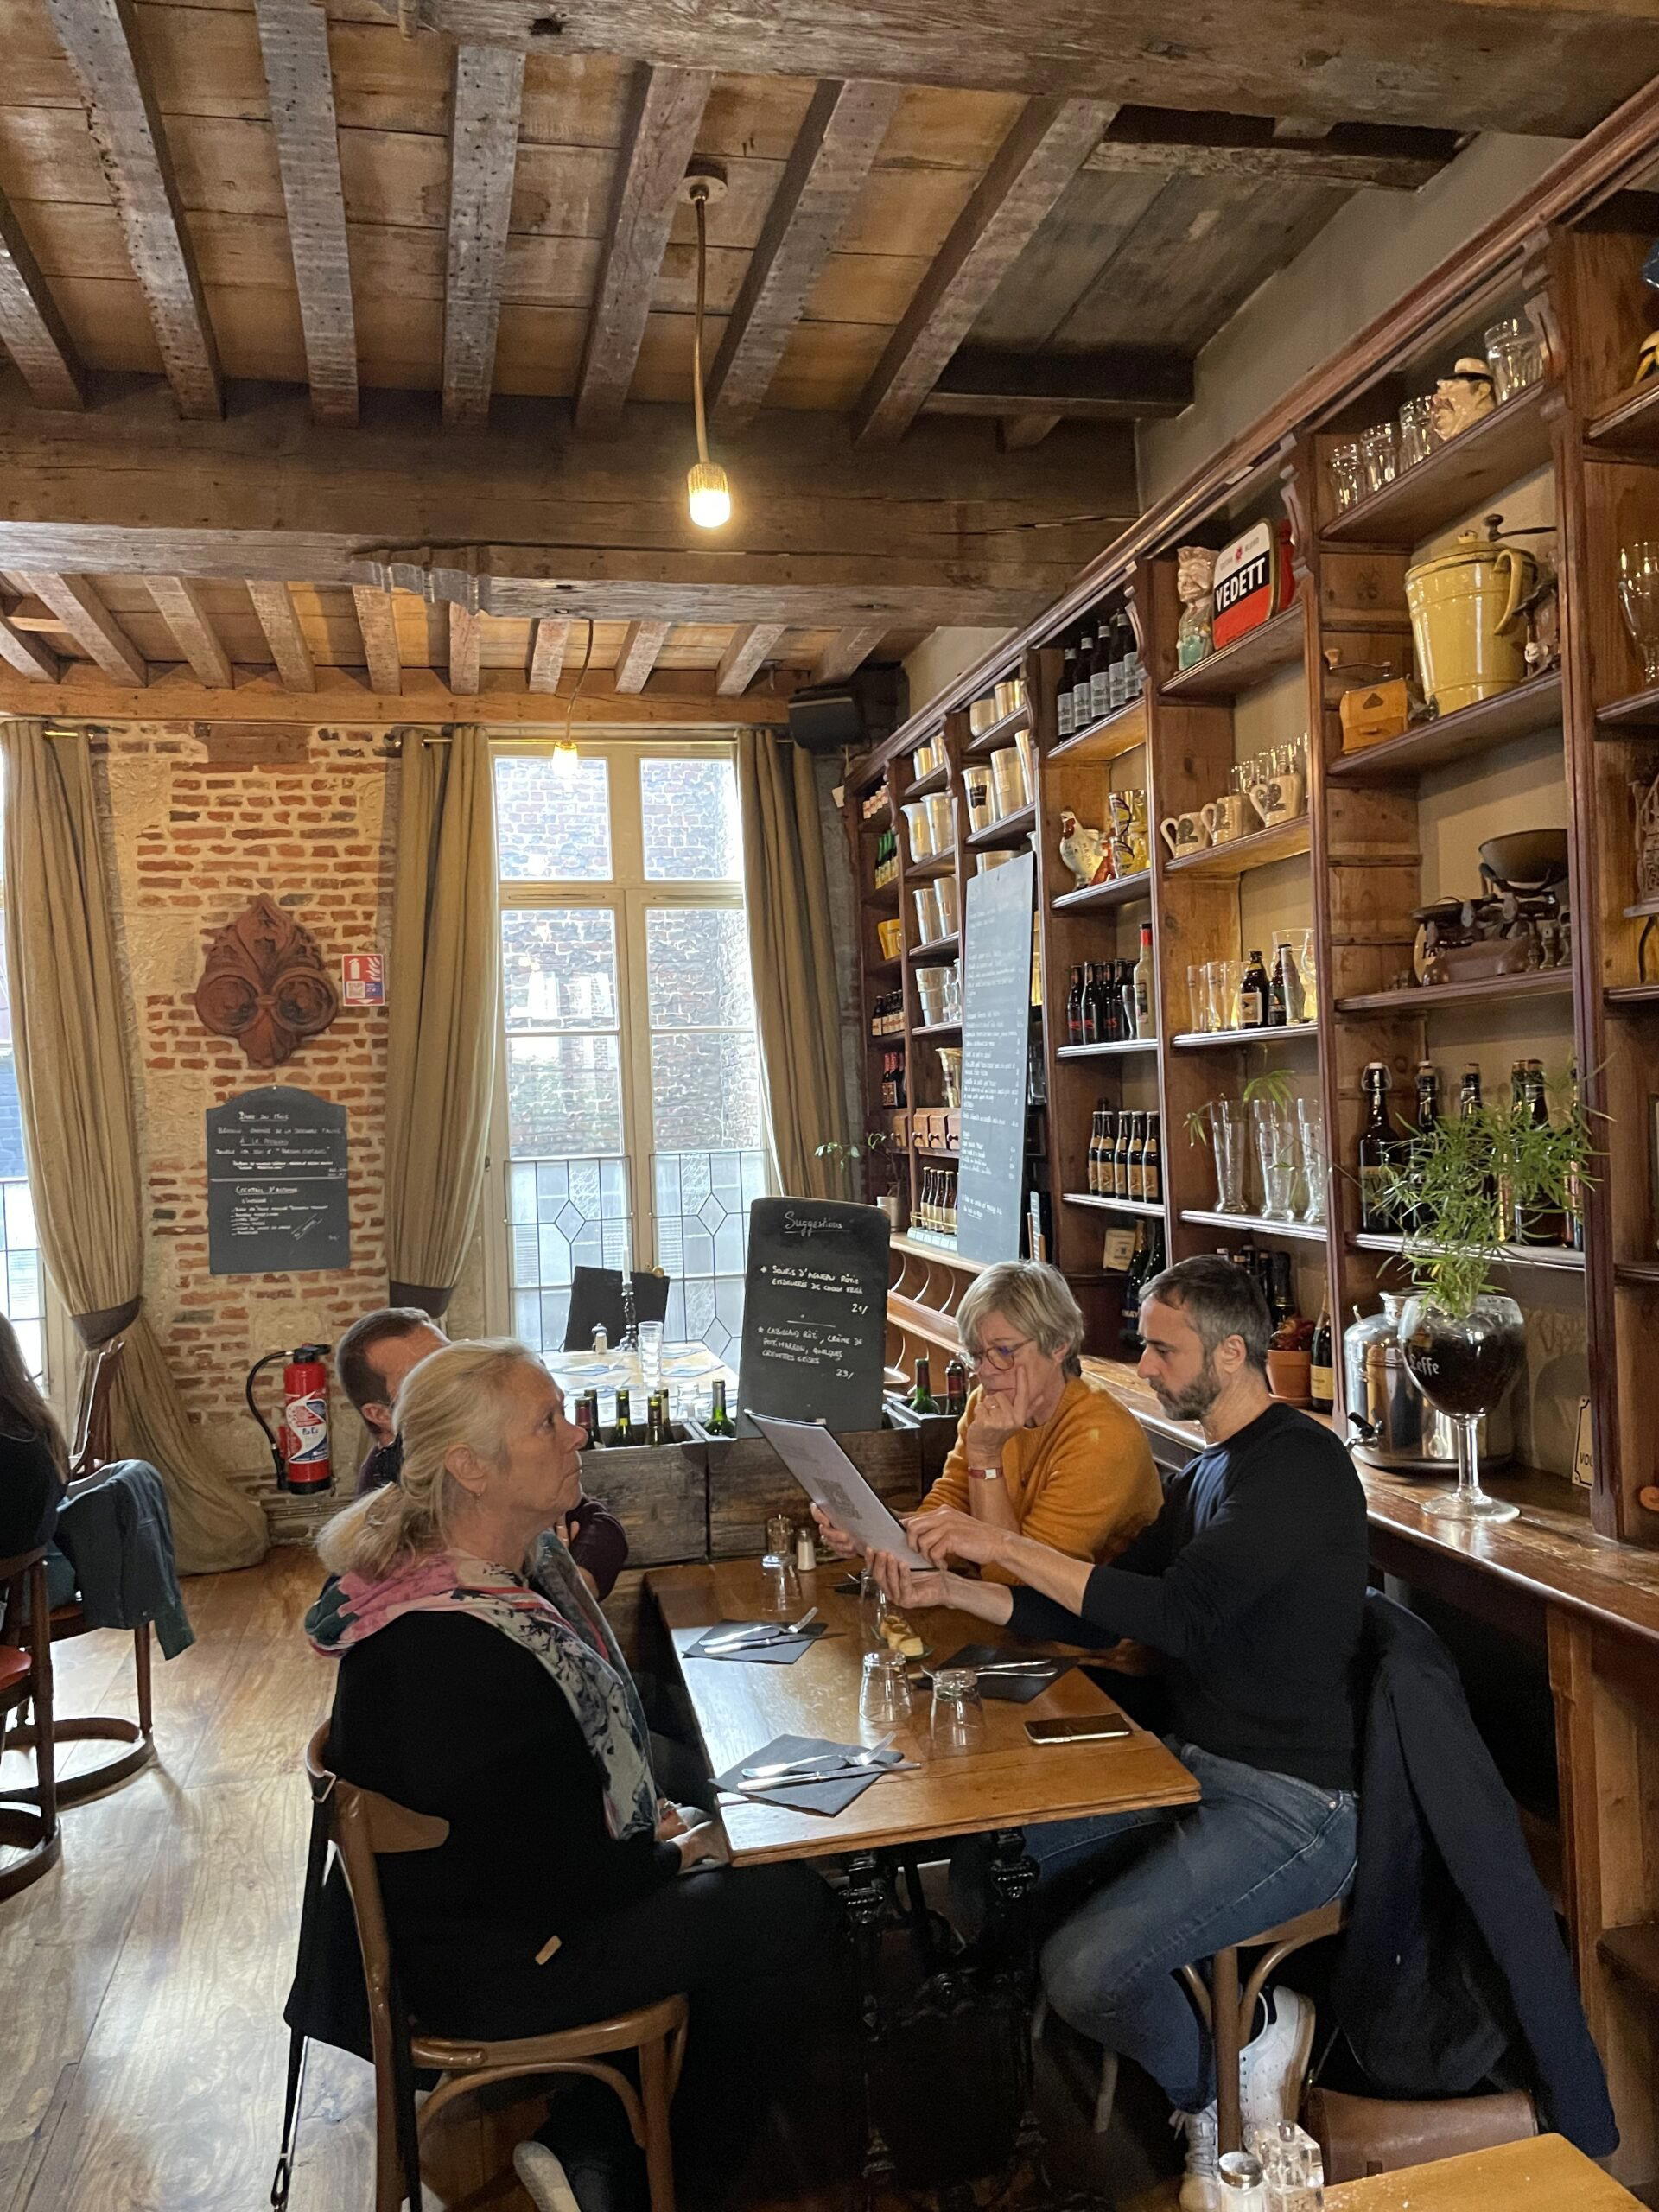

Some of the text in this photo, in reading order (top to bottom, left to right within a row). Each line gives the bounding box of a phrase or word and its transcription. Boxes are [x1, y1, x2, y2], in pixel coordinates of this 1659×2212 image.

[1216, 557, 1266, 613] VEDETT
[784, 1211, 844, 1236] Suggestions
[1408, 1353, 1440, 1376] Leffe
